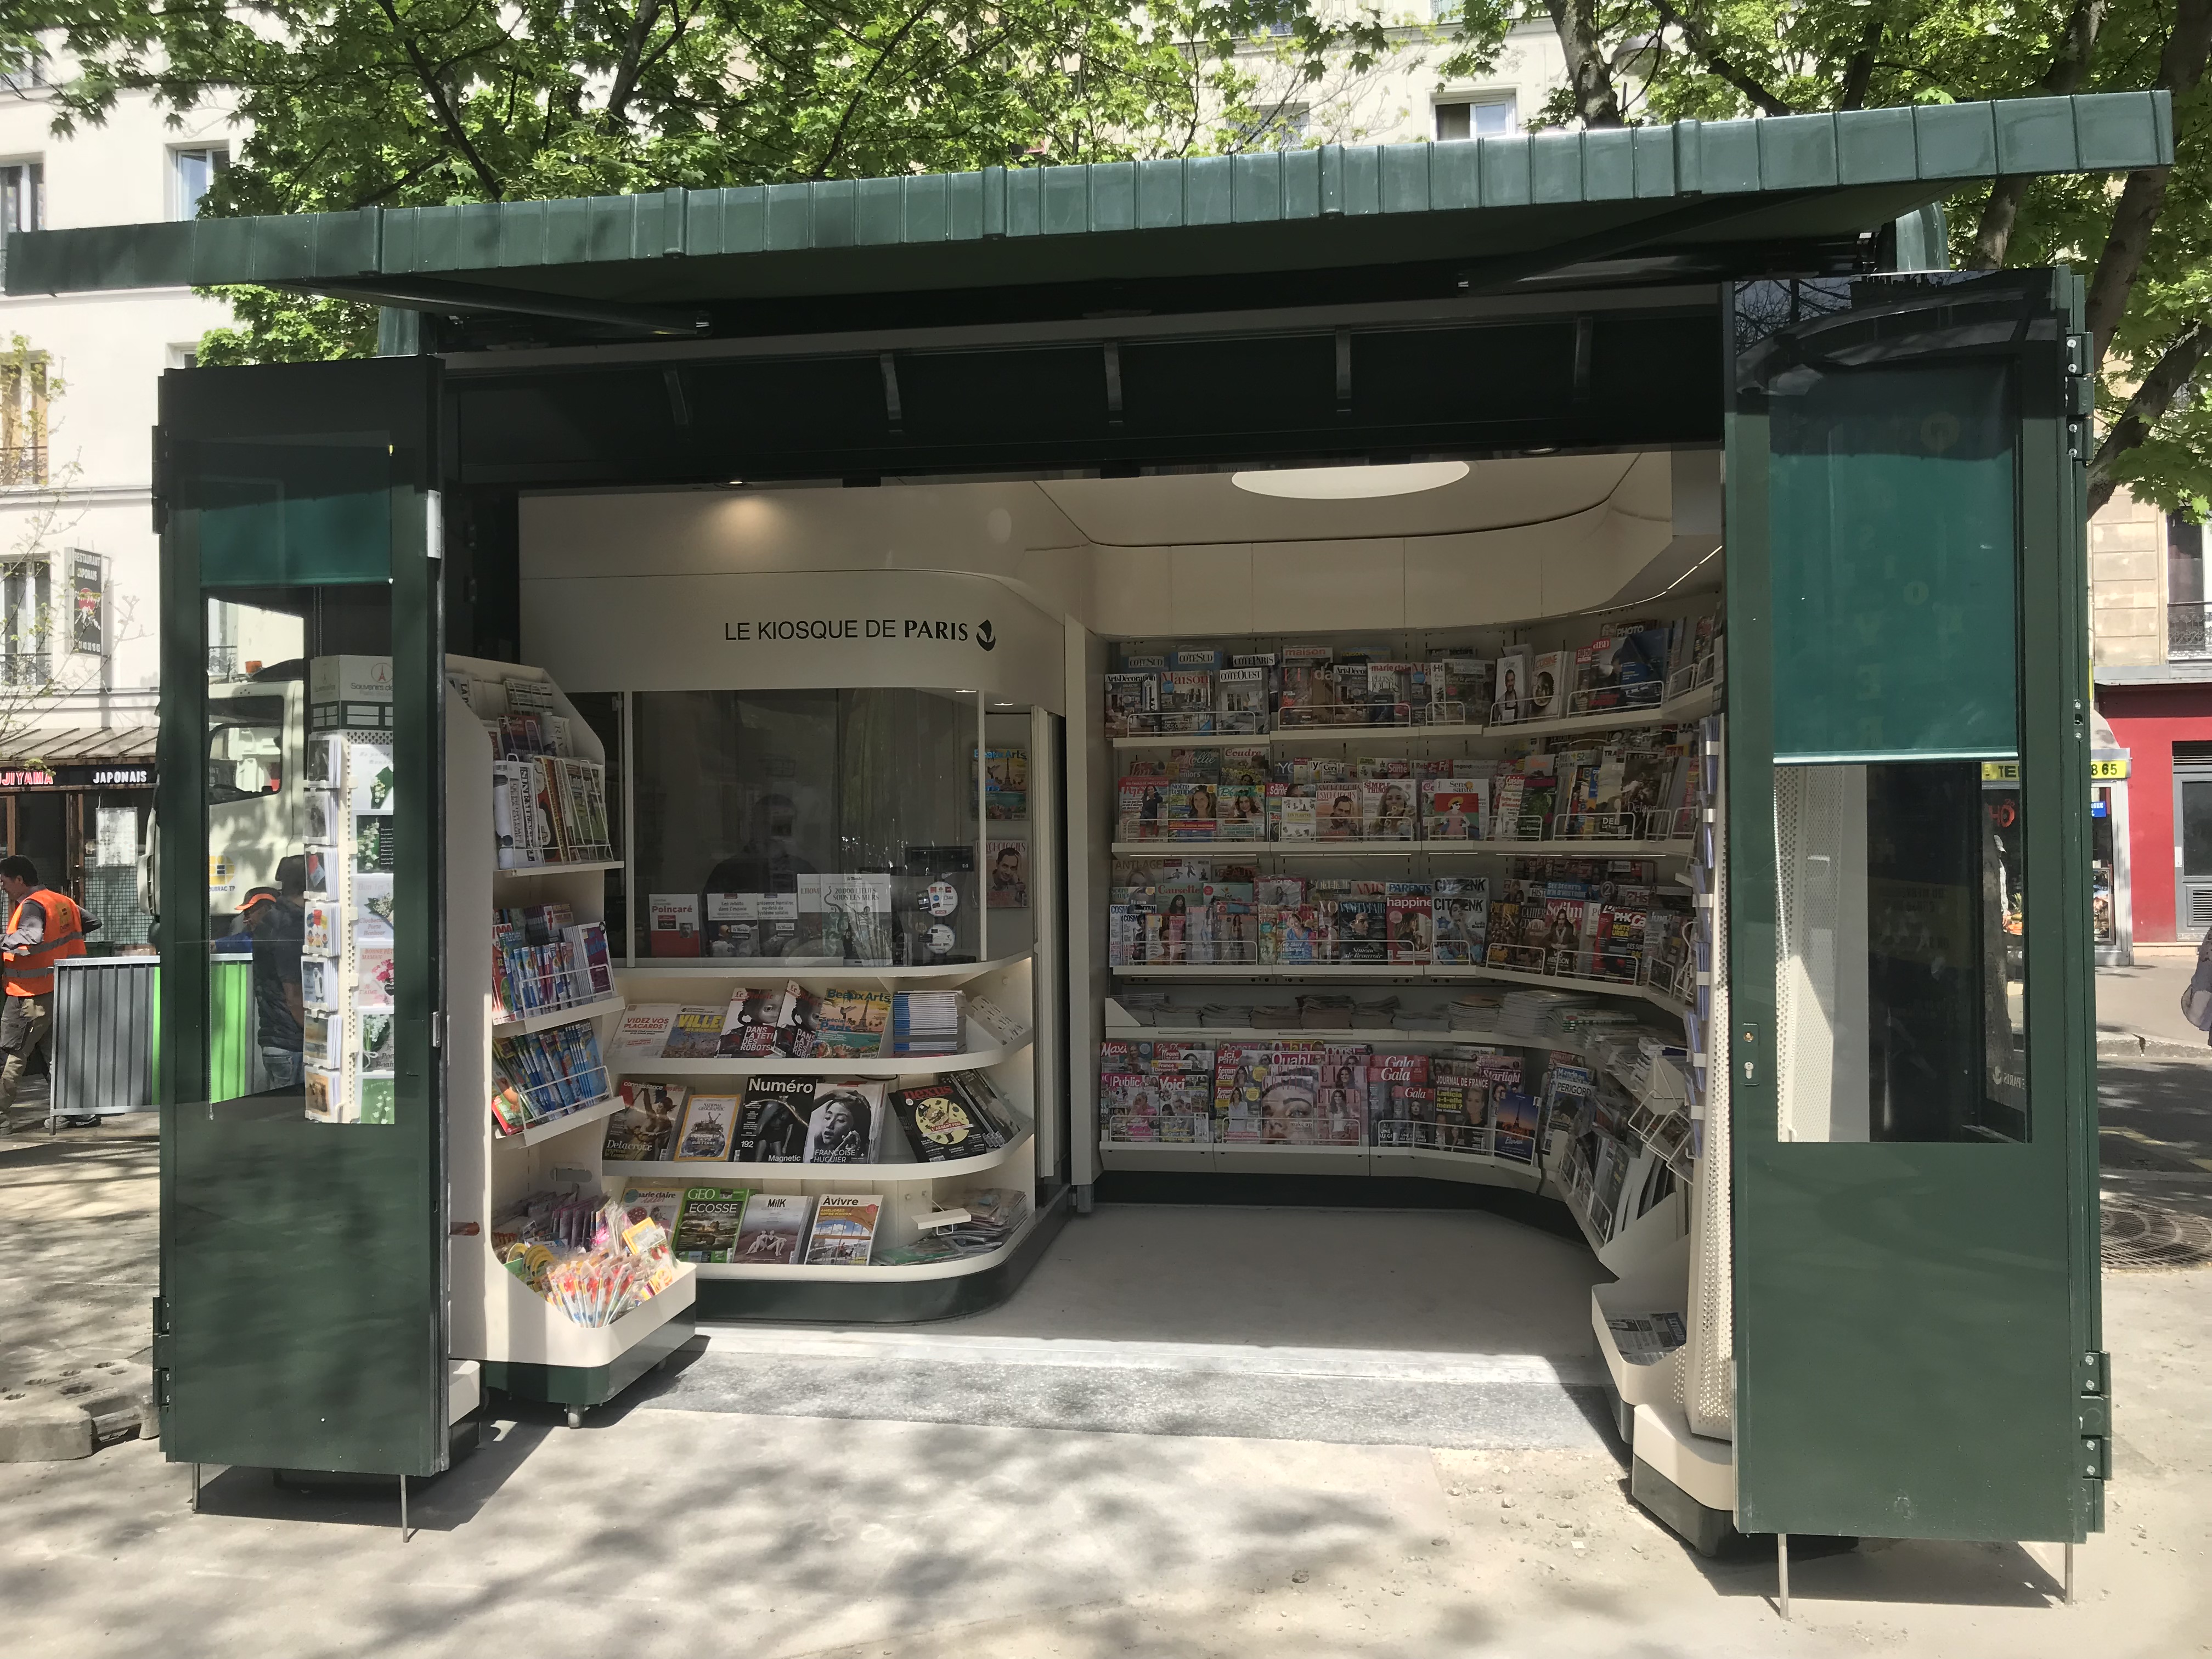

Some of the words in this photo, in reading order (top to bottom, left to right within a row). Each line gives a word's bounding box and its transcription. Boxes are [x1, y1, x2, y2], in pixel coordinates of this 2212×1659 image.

[725, 622, 751, 641] LE
[758, 620, 858, 640] KIOSQUE
[866, 619, 896, 639] DE
[903, 620, 968, 641] PARIS
[1285, 648, 1326, 656] maison
[1161, 672, 1210, 685] Maison
[351, 682, 383, 691] Souvenirs
[1997, 765, 2020, 777] TE
[2102, 763, 2118, 775] 65
[93, 771, 147, 783] JAPONAIS
[1115, 860, 1163, 870] ANTI-AGE
[1158, 884, 1200, 894] Causette
[652, 905, 693, 913] Poincaré
[865, 992, 892, 1003] Arts
[1101, 1042, 1127, 1057] Maxi
[1271, 1052, 1311, 1065] Ouah!
[1380, 1066, 1410, 1081] Gala
[623, 1080, 664, 1091] connaissance
[748, 1077, 814, 1093] Numéro
[1113, 1076, 1141, 1087] Public
[1159, 1076, 1186, 1091] Voici
[1436, 1075, 1459, 1086] JOURNAL
[1460, 1077, 1468, 1086] DE
[1468, 1078, 1489, 1088] FRANCE
[902, 1086, 954, 1100] nexus
[1404, 1087, 1426, 1099] Gala
[931, 1123, 951, 1131] L'ARGENT
[607, 1139, 652, 1152] Delacroix
[741, 1140, 754, 1148] 192
[768, 1154, 801, 1163] Magnetic
[815, 1148, 856, 1158] FRANÇOISE
[687, 1188, 715, 1200] GEO
[768, 1198, 786, 1208] MilK
